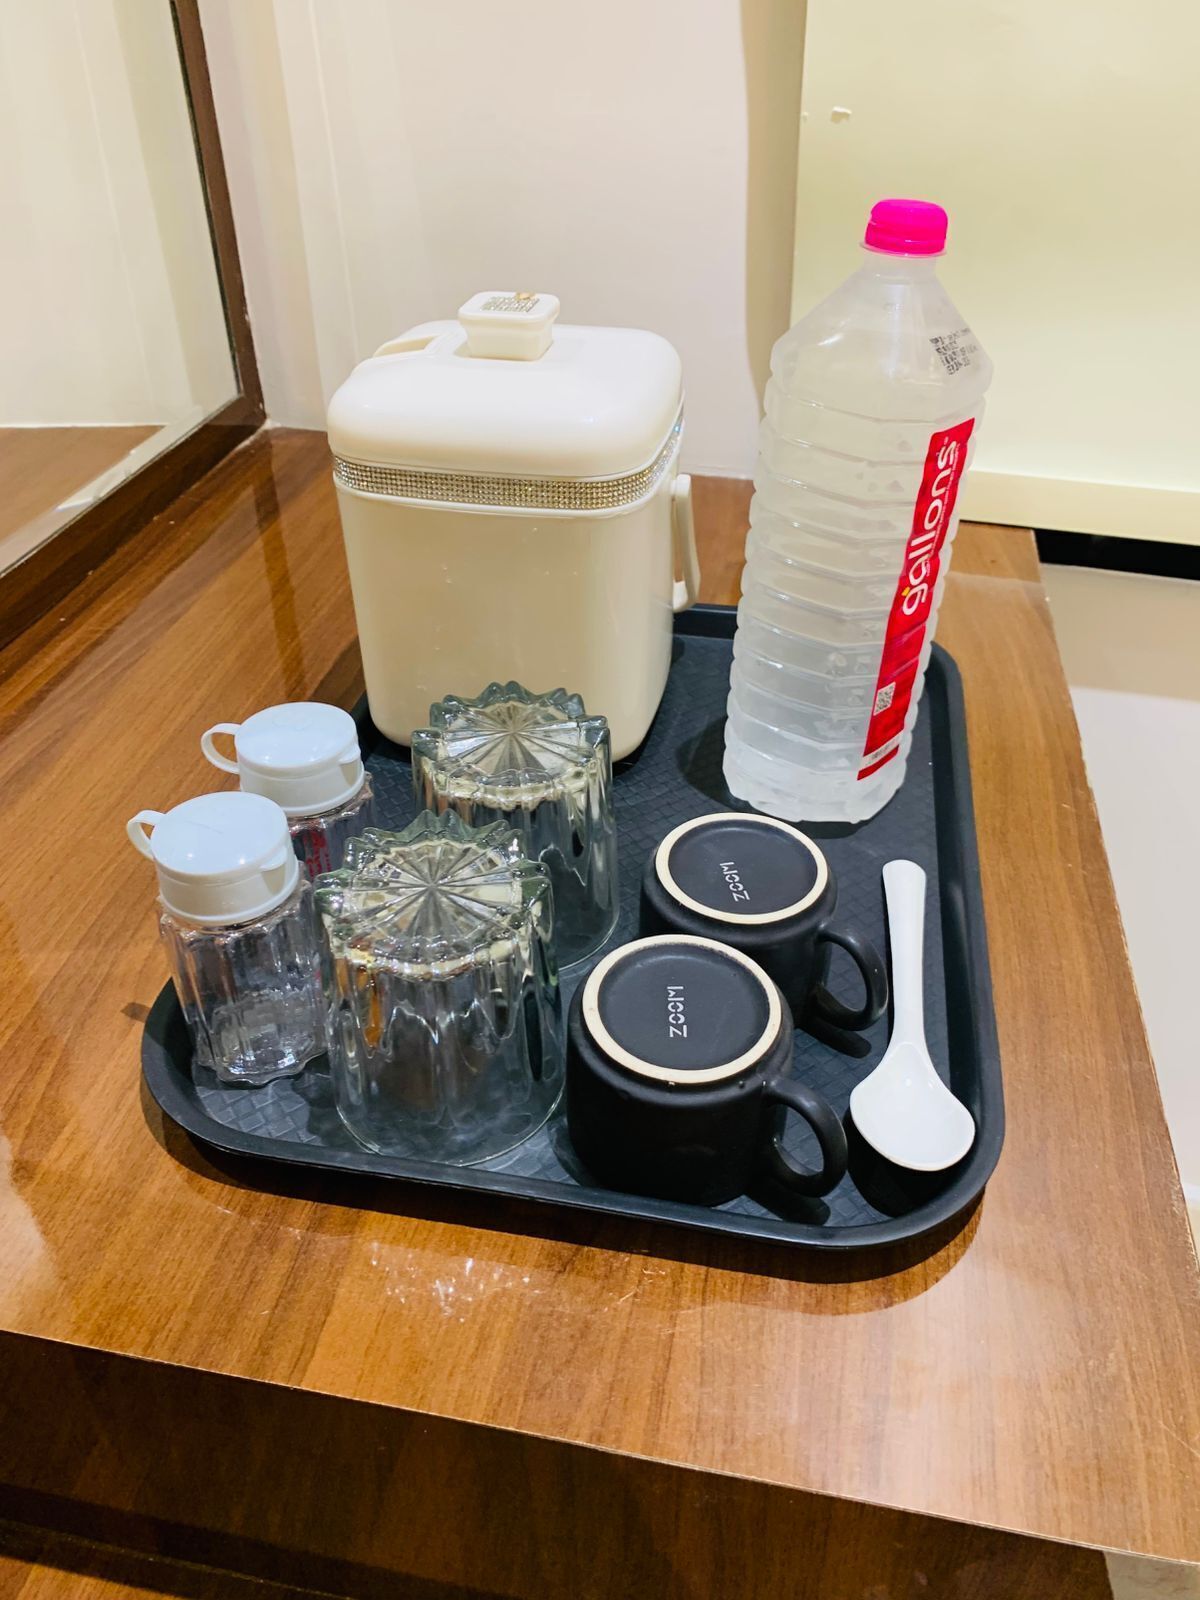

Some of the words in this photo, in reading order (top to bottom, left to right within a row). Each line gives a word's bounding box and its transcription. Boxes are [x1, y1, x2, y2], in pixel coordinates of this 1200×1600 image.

[902, 440, 957, 616] gallons
[719, 861, 750, 902] ZOOM
[666, 985, 688, 1038] ZOOM
